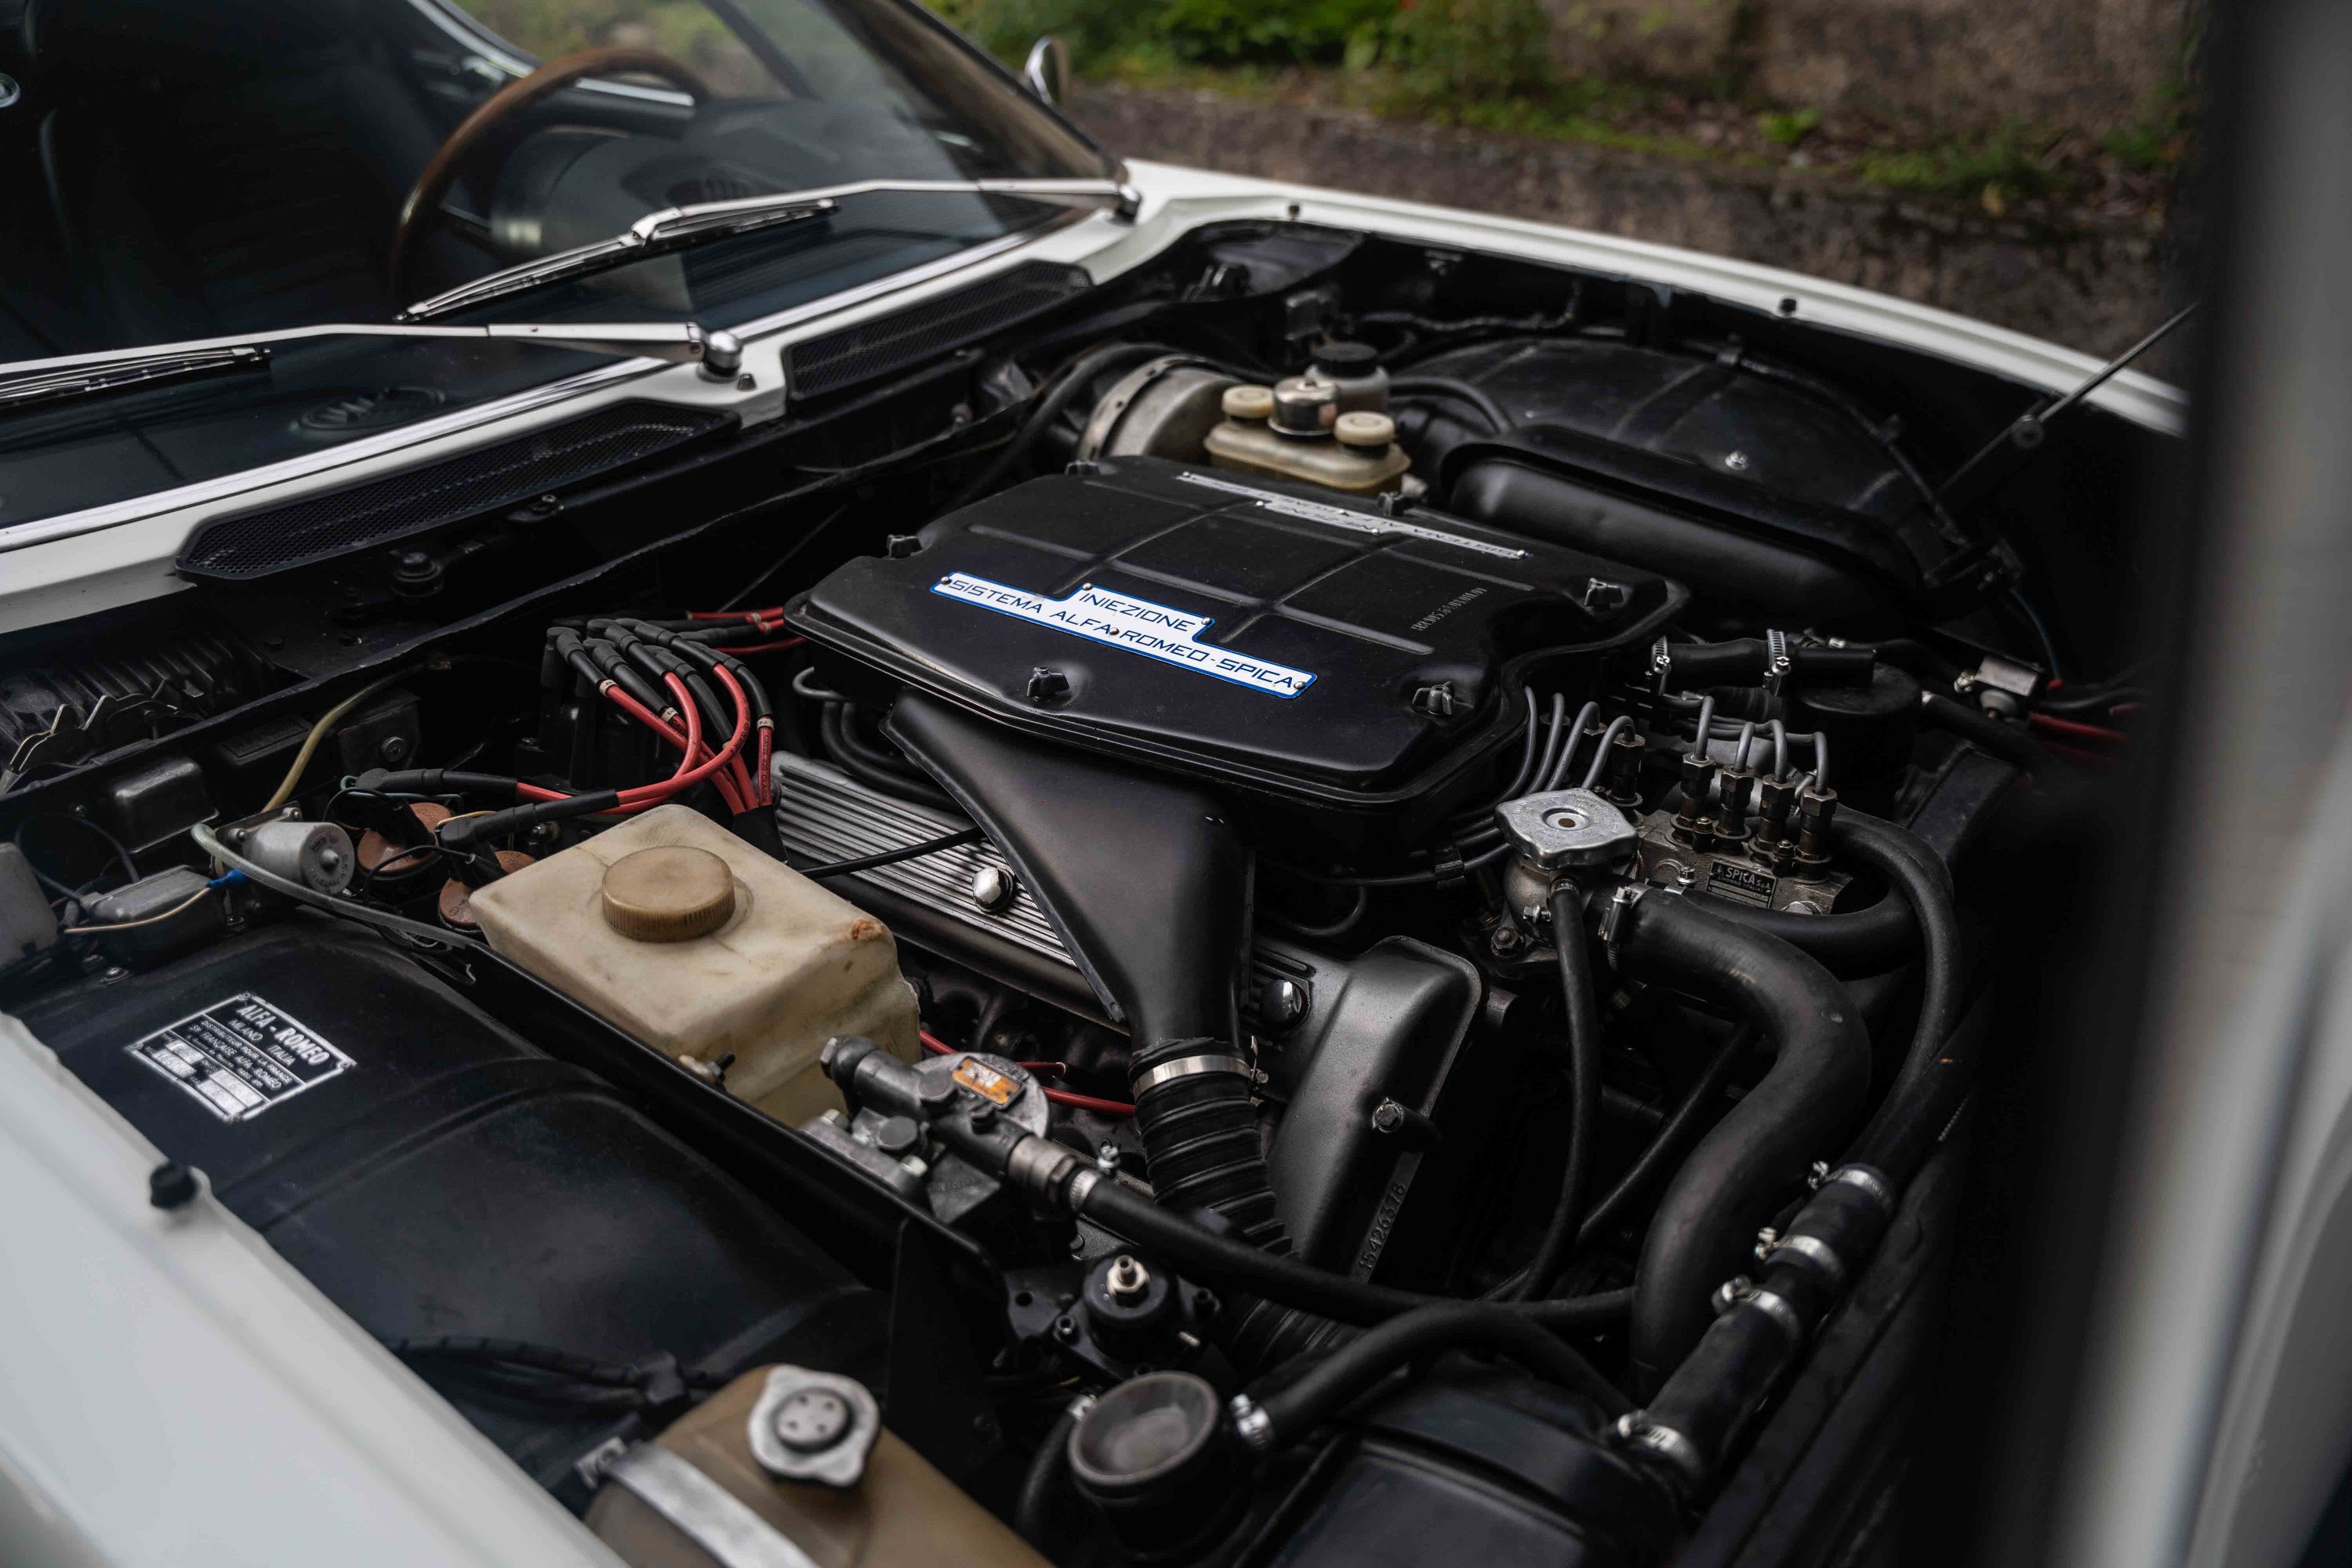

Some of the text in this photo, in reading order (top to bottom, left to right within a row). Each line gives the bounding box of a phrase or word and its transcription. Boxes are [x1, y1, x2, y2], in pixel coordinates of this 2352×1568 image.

[949, 579, 1042, 614] SISTEMA
[1050, 611, 1111, 634] ALFA
[1079, 592, 1195, 632] INIEZIONE
[1718, 876, 1741, 885] LIVORNO
[1726, 867, 1755, 884] SPICA
[201, 1020, 293, 1084] DISTRIBUTEUR POUR LA FRANCE
[227, 1018, 296, 1066] MILANO ITALIA
